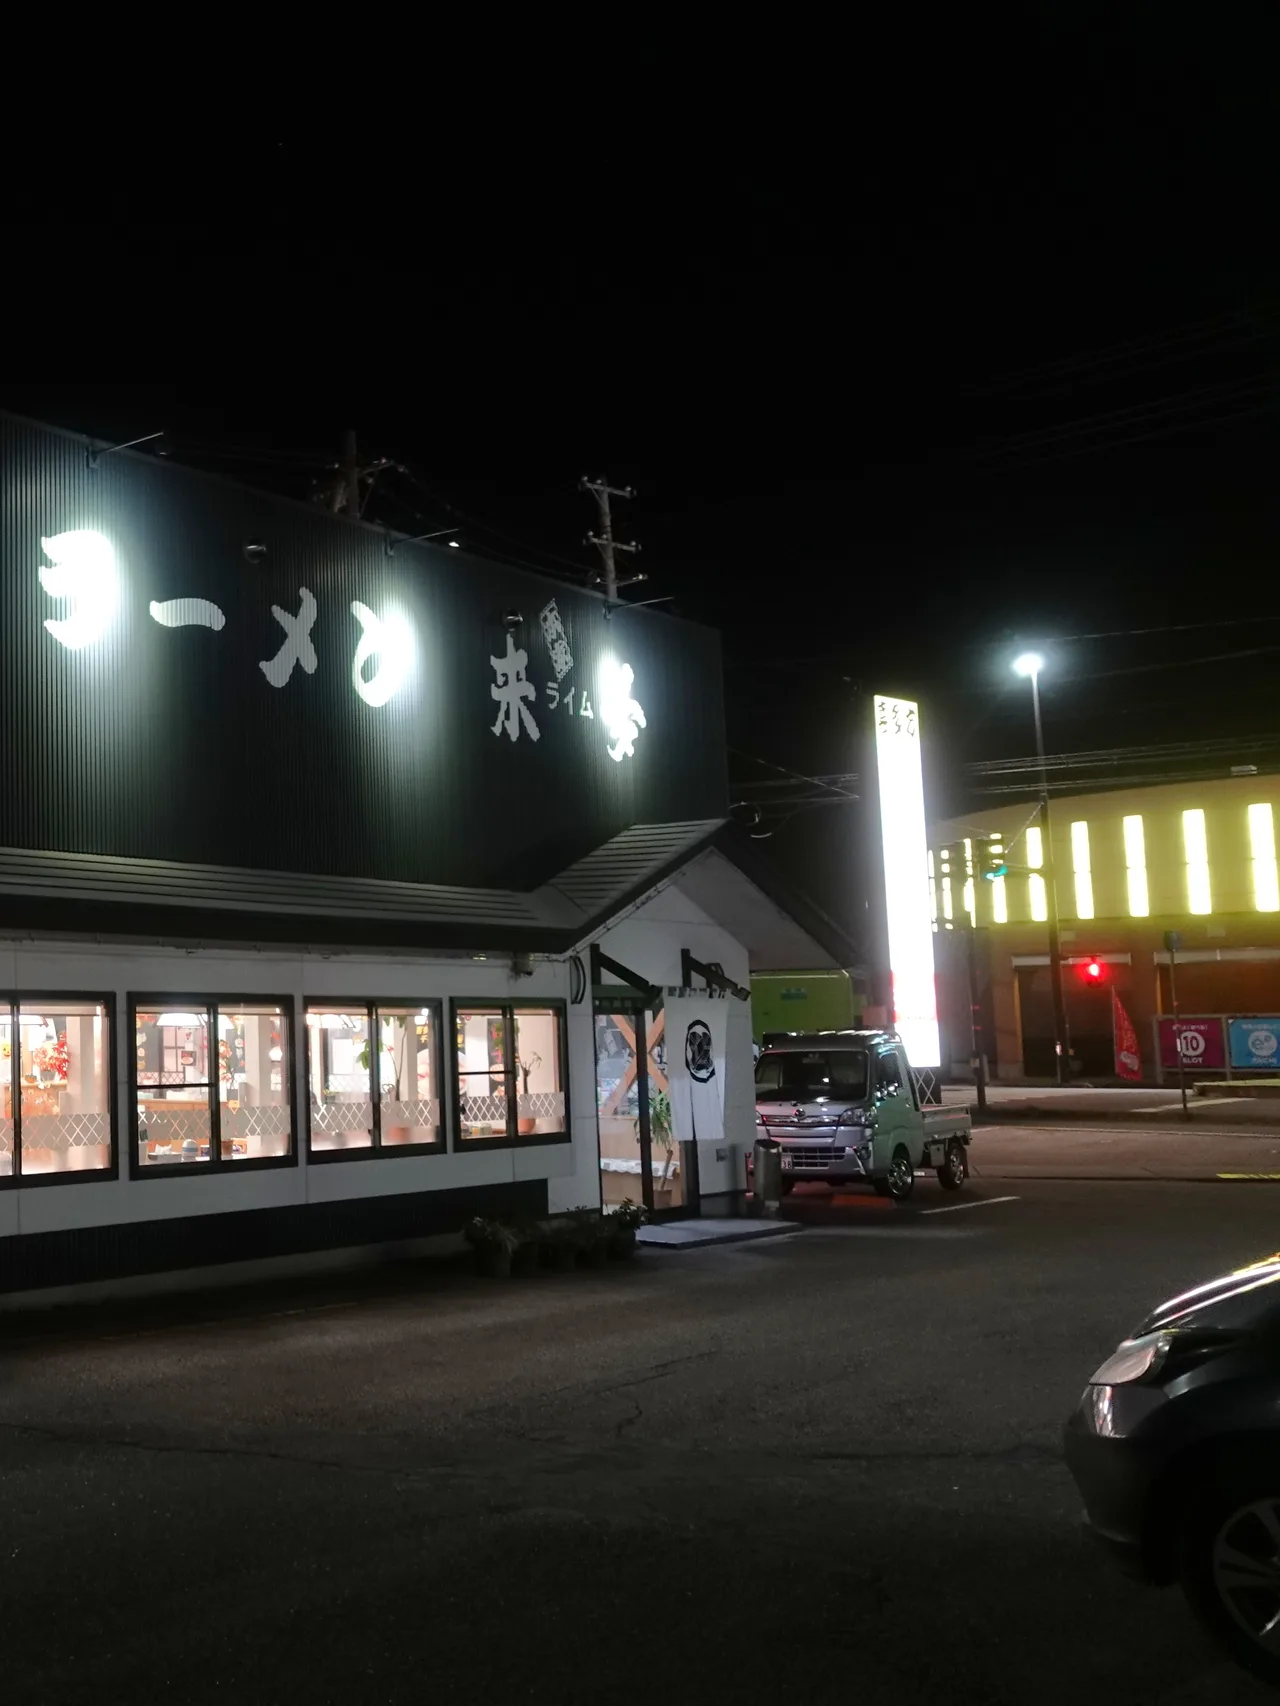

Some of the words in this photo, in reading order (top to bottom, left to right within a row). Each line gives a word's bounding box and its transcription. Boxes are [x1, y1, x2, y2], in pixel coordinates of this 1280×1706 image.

[546, 682, 594, 719] ライム
[1183, 1036, 1199, 1051] 10
